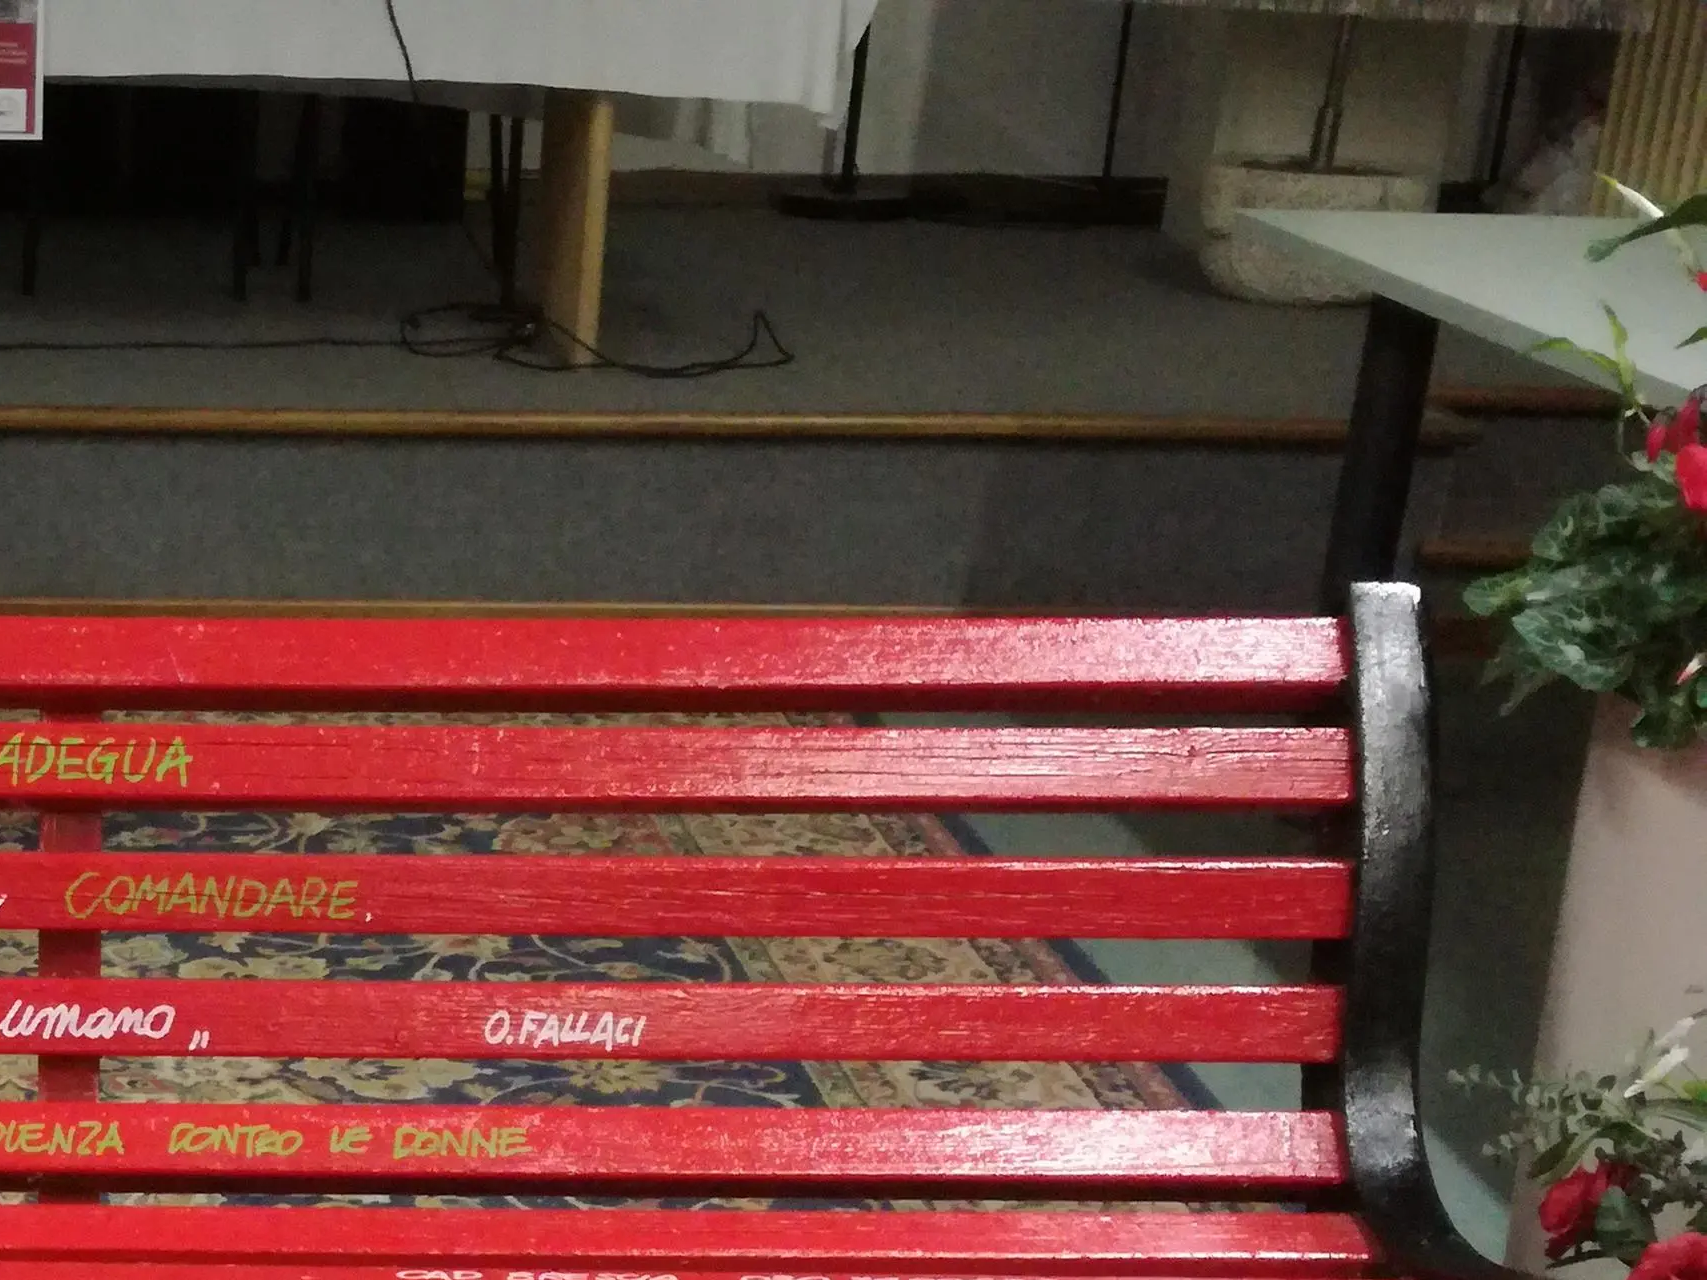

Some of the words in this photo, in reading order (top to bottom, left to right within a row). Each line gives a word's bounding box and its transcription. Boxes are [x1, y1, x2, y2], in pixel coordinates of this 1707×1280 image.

[484, 1008, 647, 1052] O.FALLACI
[328, 1125, 374, 1154] LE
[391, 1125, 531, 1161] DONNE
